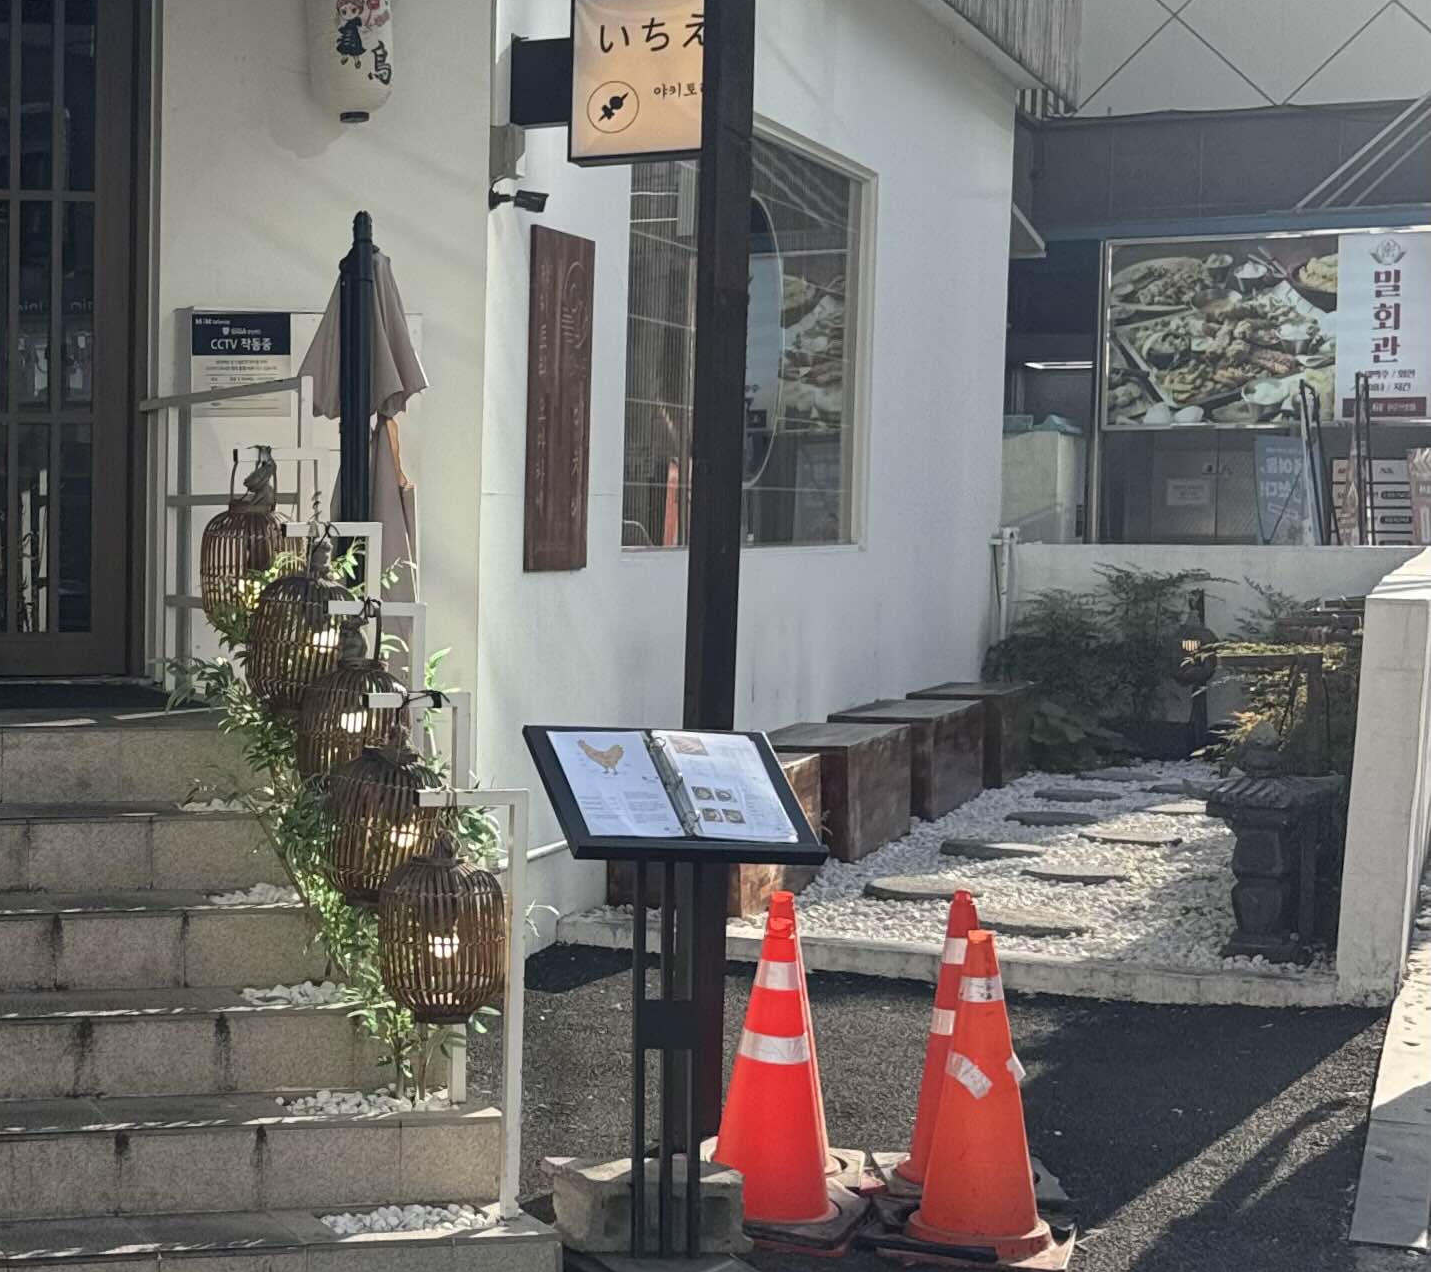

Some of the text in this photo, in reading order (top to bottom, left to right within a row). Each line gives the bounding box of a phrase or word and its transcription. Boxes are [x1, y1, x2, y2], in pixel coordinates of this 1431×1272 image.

[653, 82, 704, 98] 야키토
[1371, 269, 1401, 364] 밀회관
[210, 337, 272, 351] CCTV 작동중
